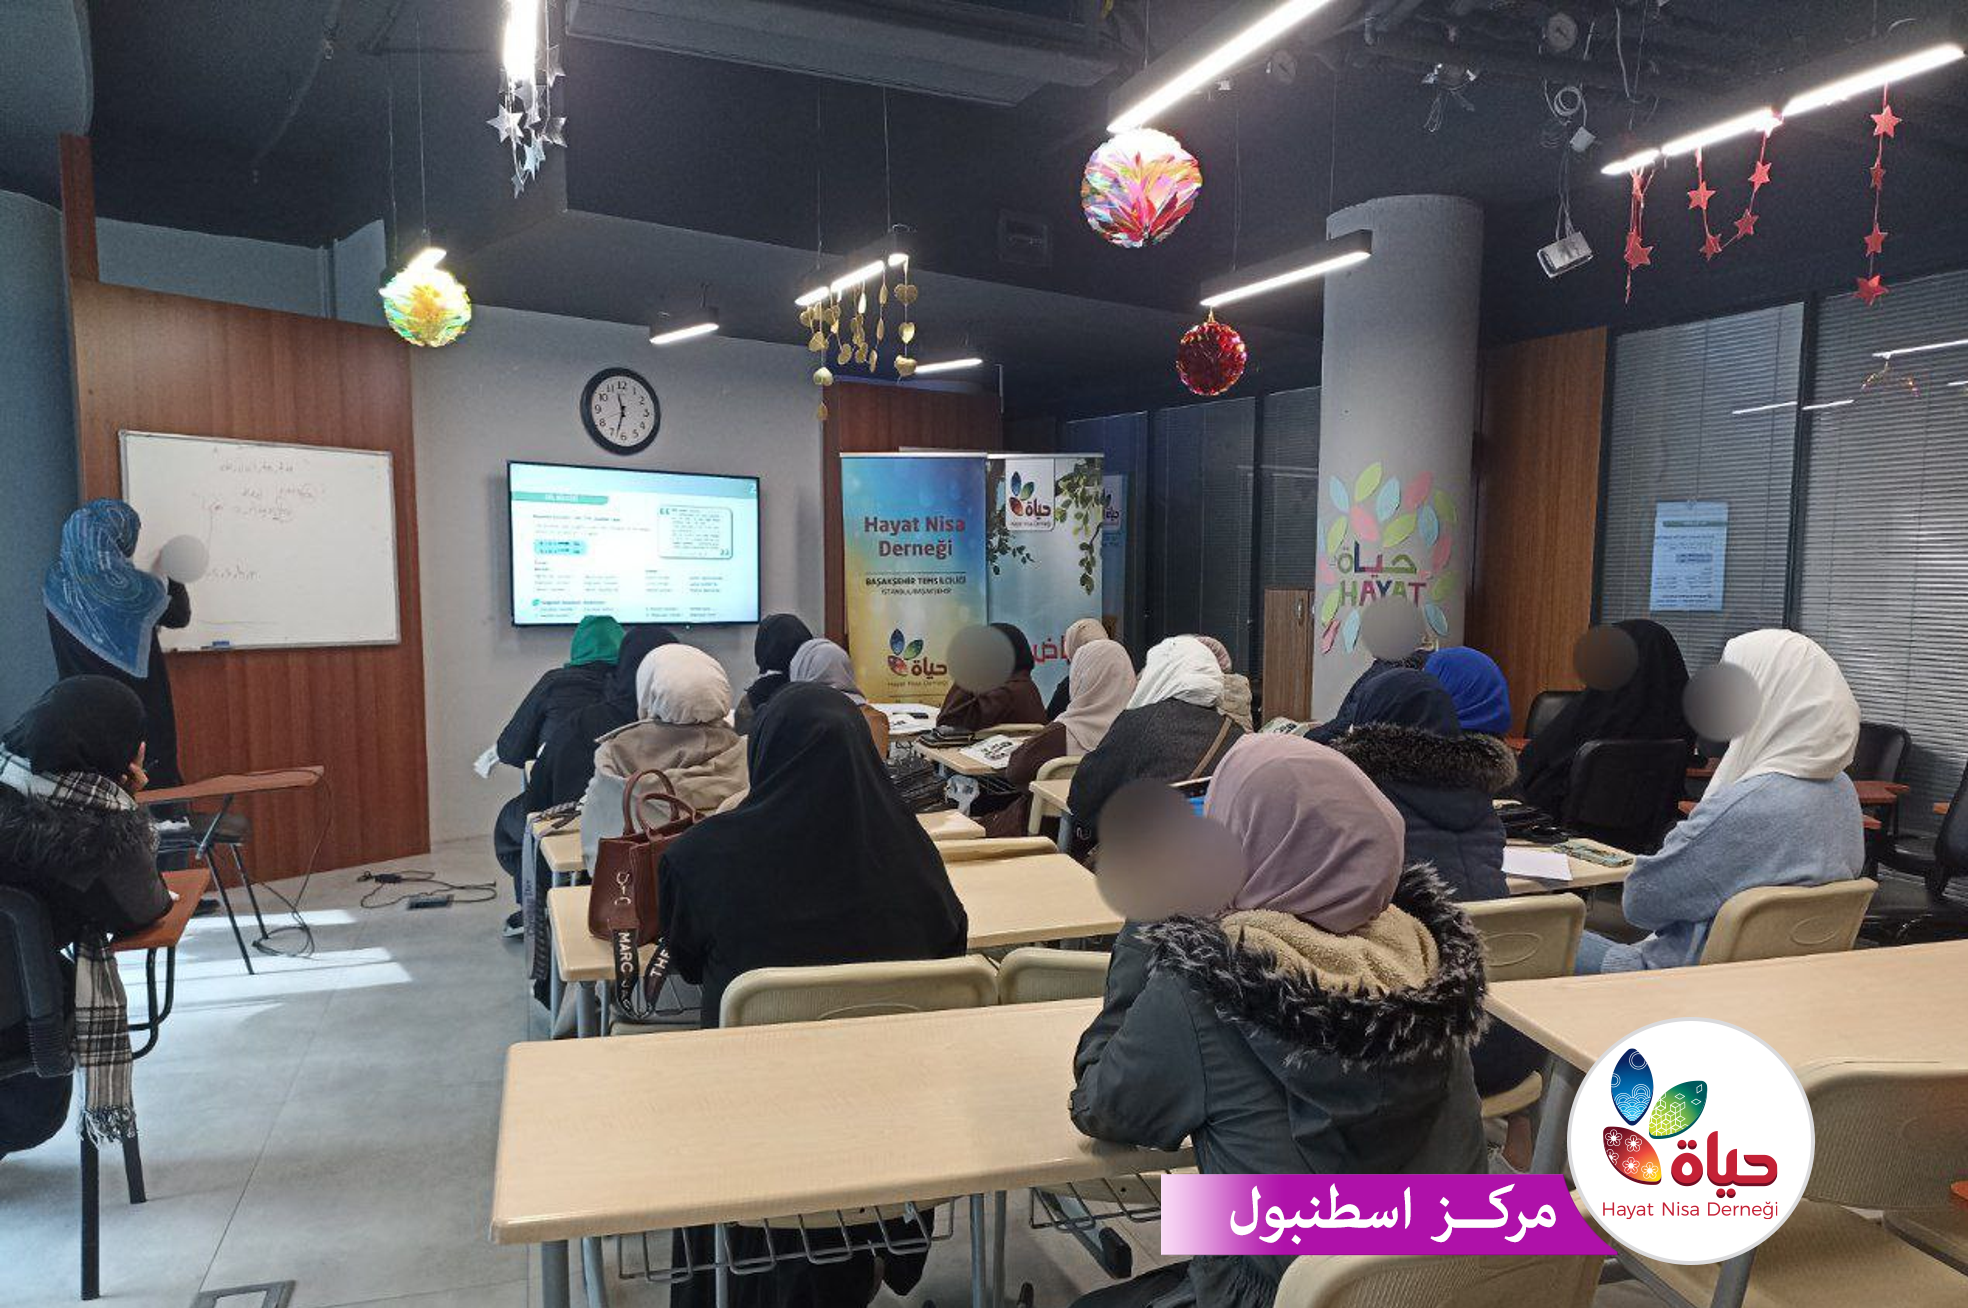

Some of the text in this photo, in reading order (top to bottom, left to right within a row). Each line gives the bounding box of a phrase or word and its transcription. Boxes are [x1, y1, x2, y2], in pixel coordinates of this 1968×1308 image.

[606, 384, 615, 393] 11
[617, 380, 627, 390] 12
[633, 386, 637, 395] 1
[599, 393, 608, 402] 10
[639, 396, 645, 405] 2
[594, 404, 602, 414] 9
[643, 409, 650, 418] 3
[599, 418, 606, 427] 8
[639, 421, 646, 430] 4
[609, 427, 615, 436] 7
[620, 431, 627, 441] 6
[632, 429, 639, 438] 5
[1025, 498, 1051, 520] حياة
[864, 515, 966, 536] Hayat Nisa
[879, 540, 953, 560] Derneği
[1337, 541, 1418, 579] حياة
[1340, 580, 1427, 608] HAYAT
[911, 656, 948, 680] حياة
[618, 931, 634, 974] MARC
